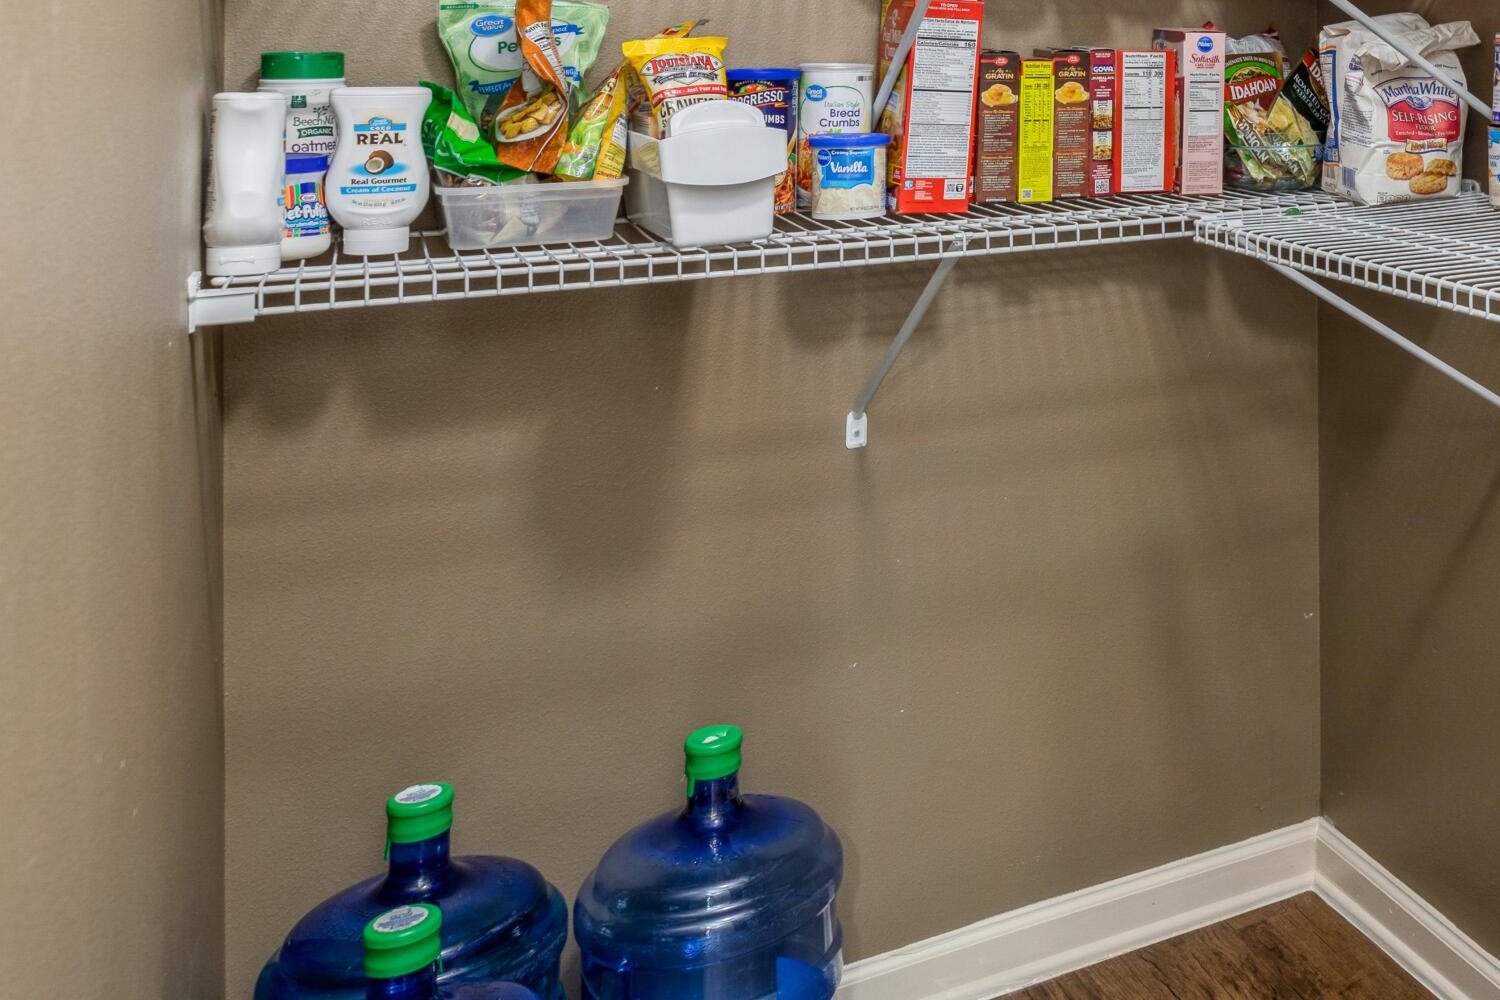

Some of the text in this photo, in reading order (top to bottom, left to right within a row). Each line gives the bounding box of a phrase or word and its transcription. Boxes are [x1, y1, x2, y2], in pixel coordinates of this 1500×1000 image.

[475, 19, 504, 27] Great
[482, 23, 504, 31] Value
[650, 55, 715, 74] LOUISIANA
[1190, 54, 1220, 64] Softasilk
[478, 85, 502, 93] PERFECT
[1230, 78, 1276, 100] IDAHOAN
[1294, 74, 1320, 108] ROASTED
[1383, 83, 1419, 102] Martha
[830, 108, 860, 118] Bread
[1392, 110, 1457, 124] SELF-RISING
[819, 118, 860, 128] Crumbs
[1239, 120, 1269, 162] IDAHOAN
[831, 162, 868, 173] Vanilla
